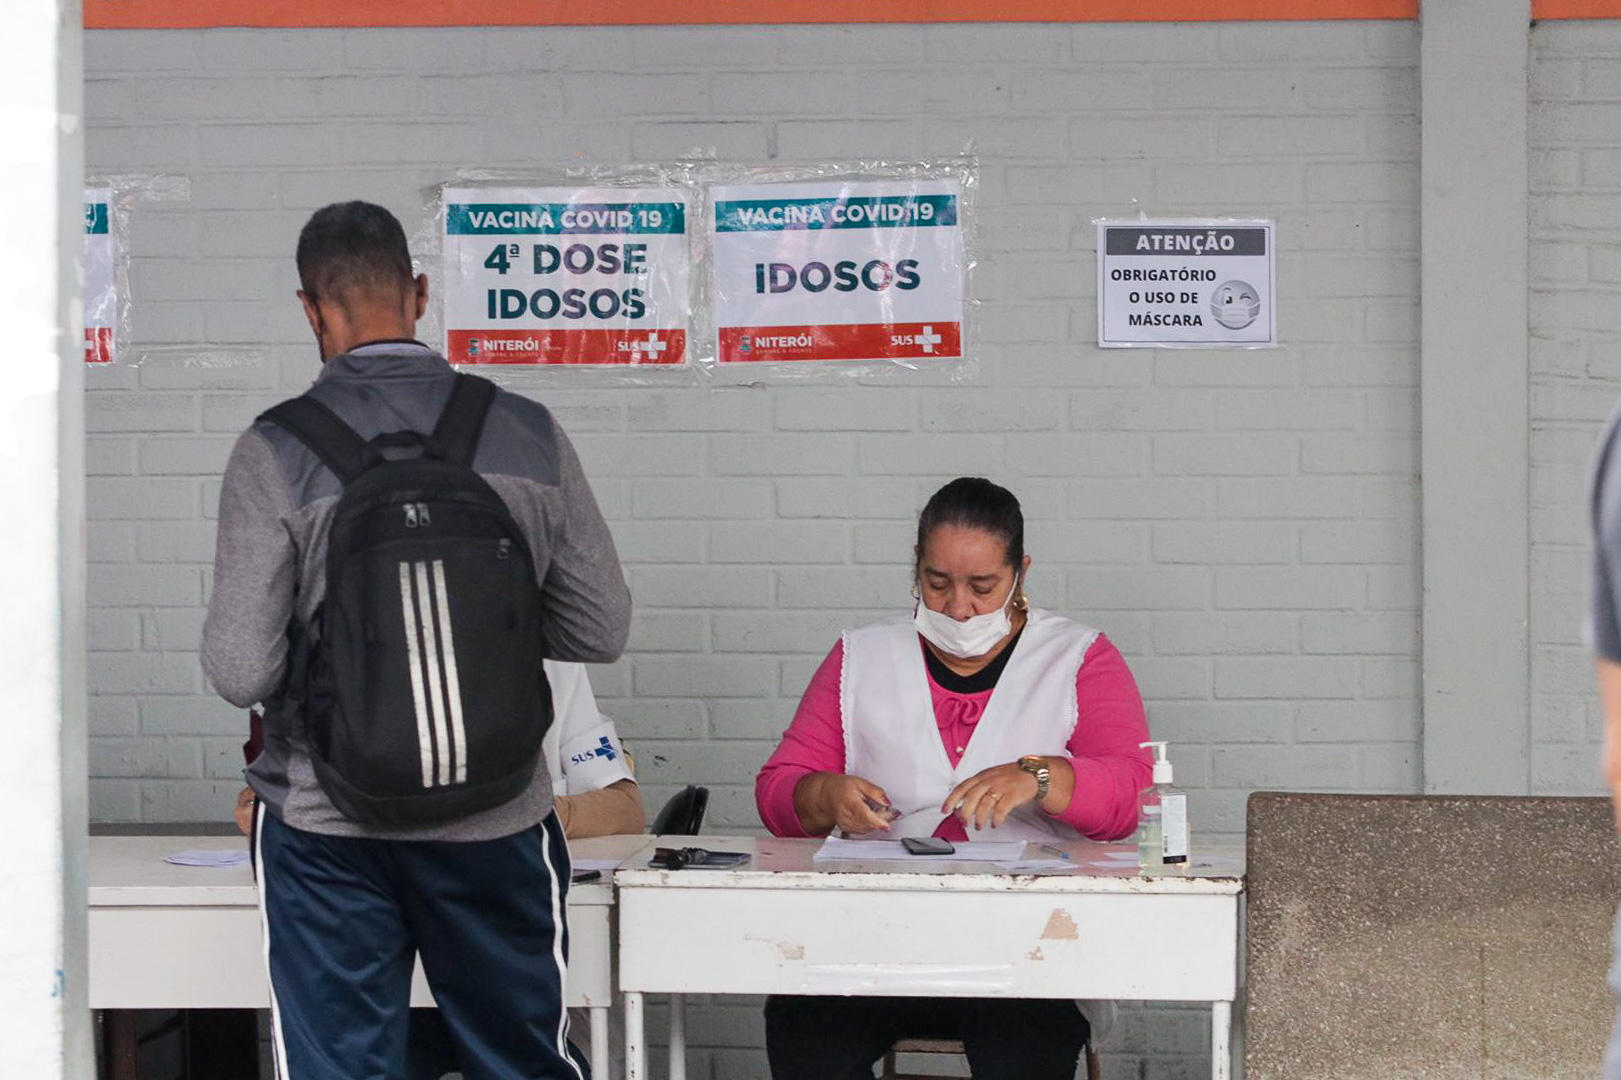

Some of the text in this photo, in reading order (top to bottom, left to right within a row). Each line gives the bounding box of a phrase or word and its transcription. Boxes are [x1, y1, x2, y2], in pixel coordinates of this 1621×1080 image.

[468, 210, 662, 229] VACINA COVID 19
[737, 202, 934, 225] VACINA COVID 19
[1136, 231, 1235, 255] ATENÇÃO
[484, 243, 648, 275] 4ª DOSE
[755, 259, 921, 294] IDOSOS
[1111, 266, 1216, 282] OBRIGATÓRIO
[488, 288, 646, 320] IDOSOS
[1129, 292, 1199, 304] O USO DE
[1128, 311, 1203, 326] MÁSCARA
[483, 336, 539, 351] NITERÓI
[617, 341, 640, 351] SUS
[755, 333, 813, 348] NITERÓI
[890, 334, 913, 346] SUS
[571, 749, 595, 765] SUS
